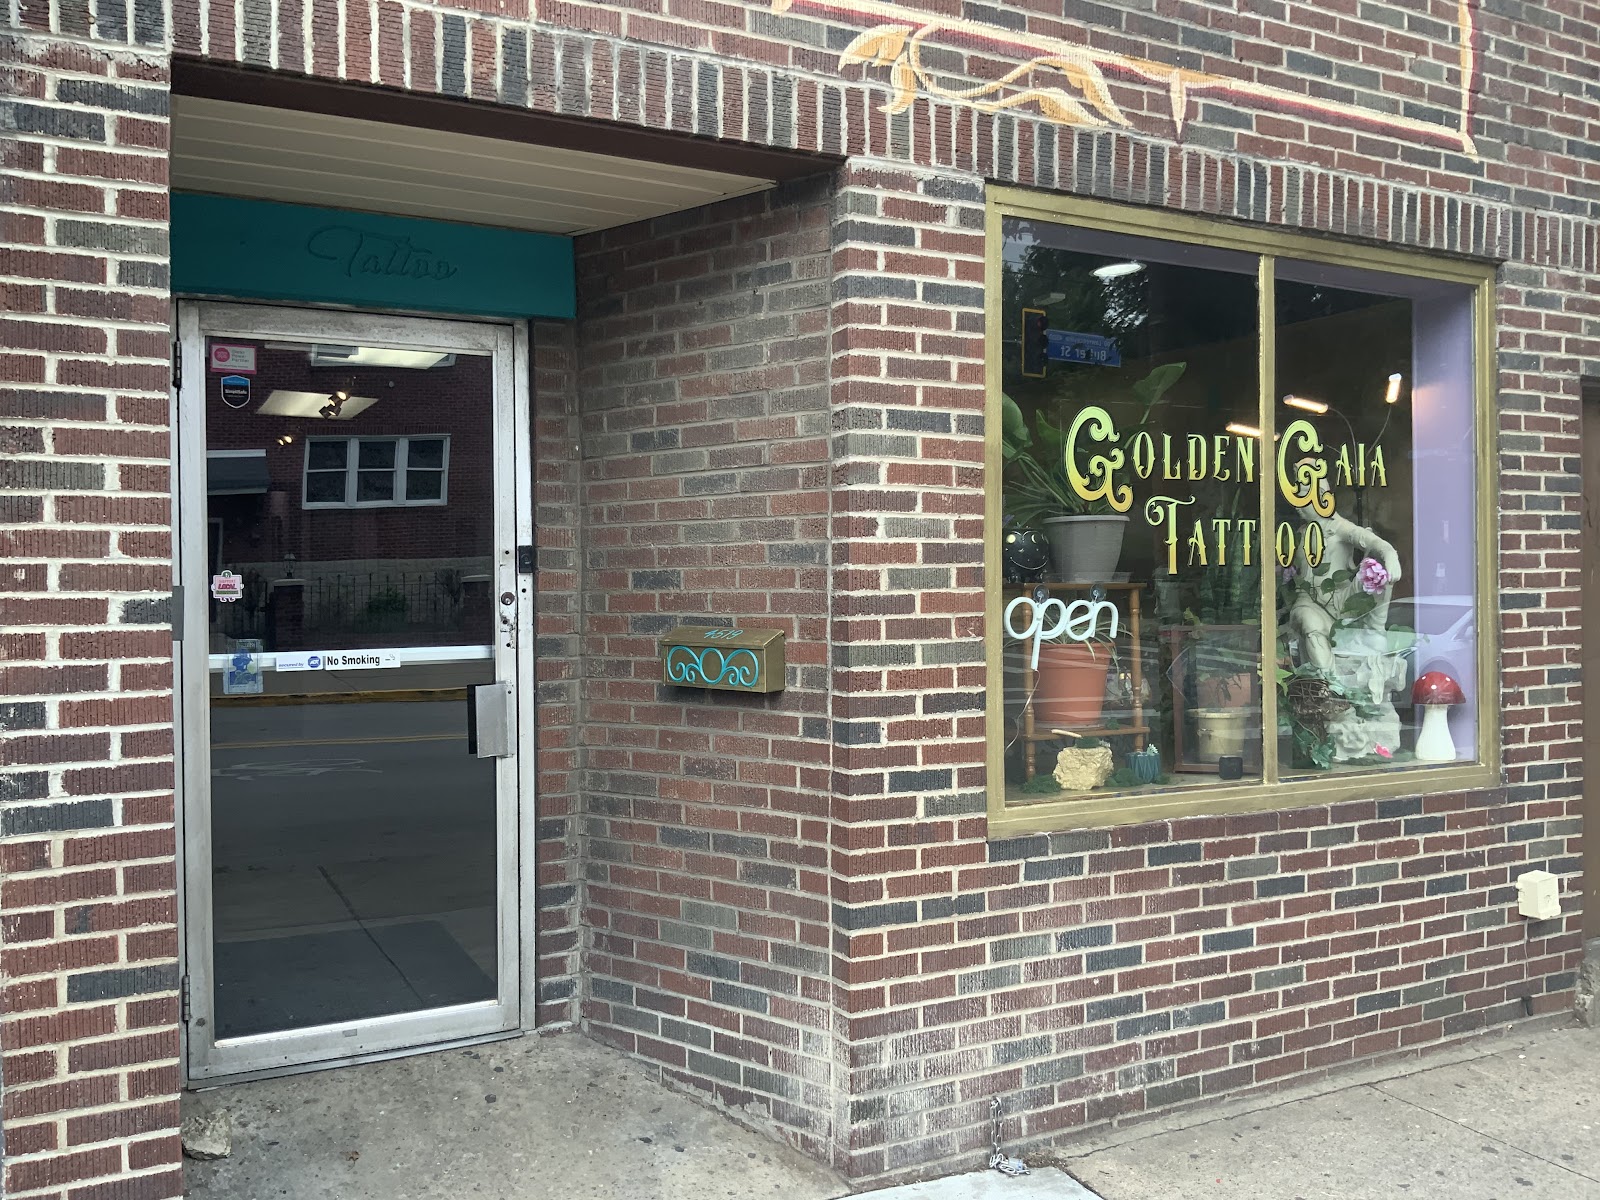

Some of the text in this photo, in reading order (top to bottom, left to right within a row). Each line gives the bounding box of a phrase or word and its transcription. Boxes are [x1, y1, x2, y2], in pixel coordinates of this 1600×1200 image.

[307, 225, 458, 280] Tattoo
[1065, 405, 1388, 519] GOLDEN GAIA
[1144, 494, 1326, 576] TATTOO
[327, 654, 381, 666] No Smoking
[703, 628, 745, 640] 4519
[1004, 596, 1119, 671] open
